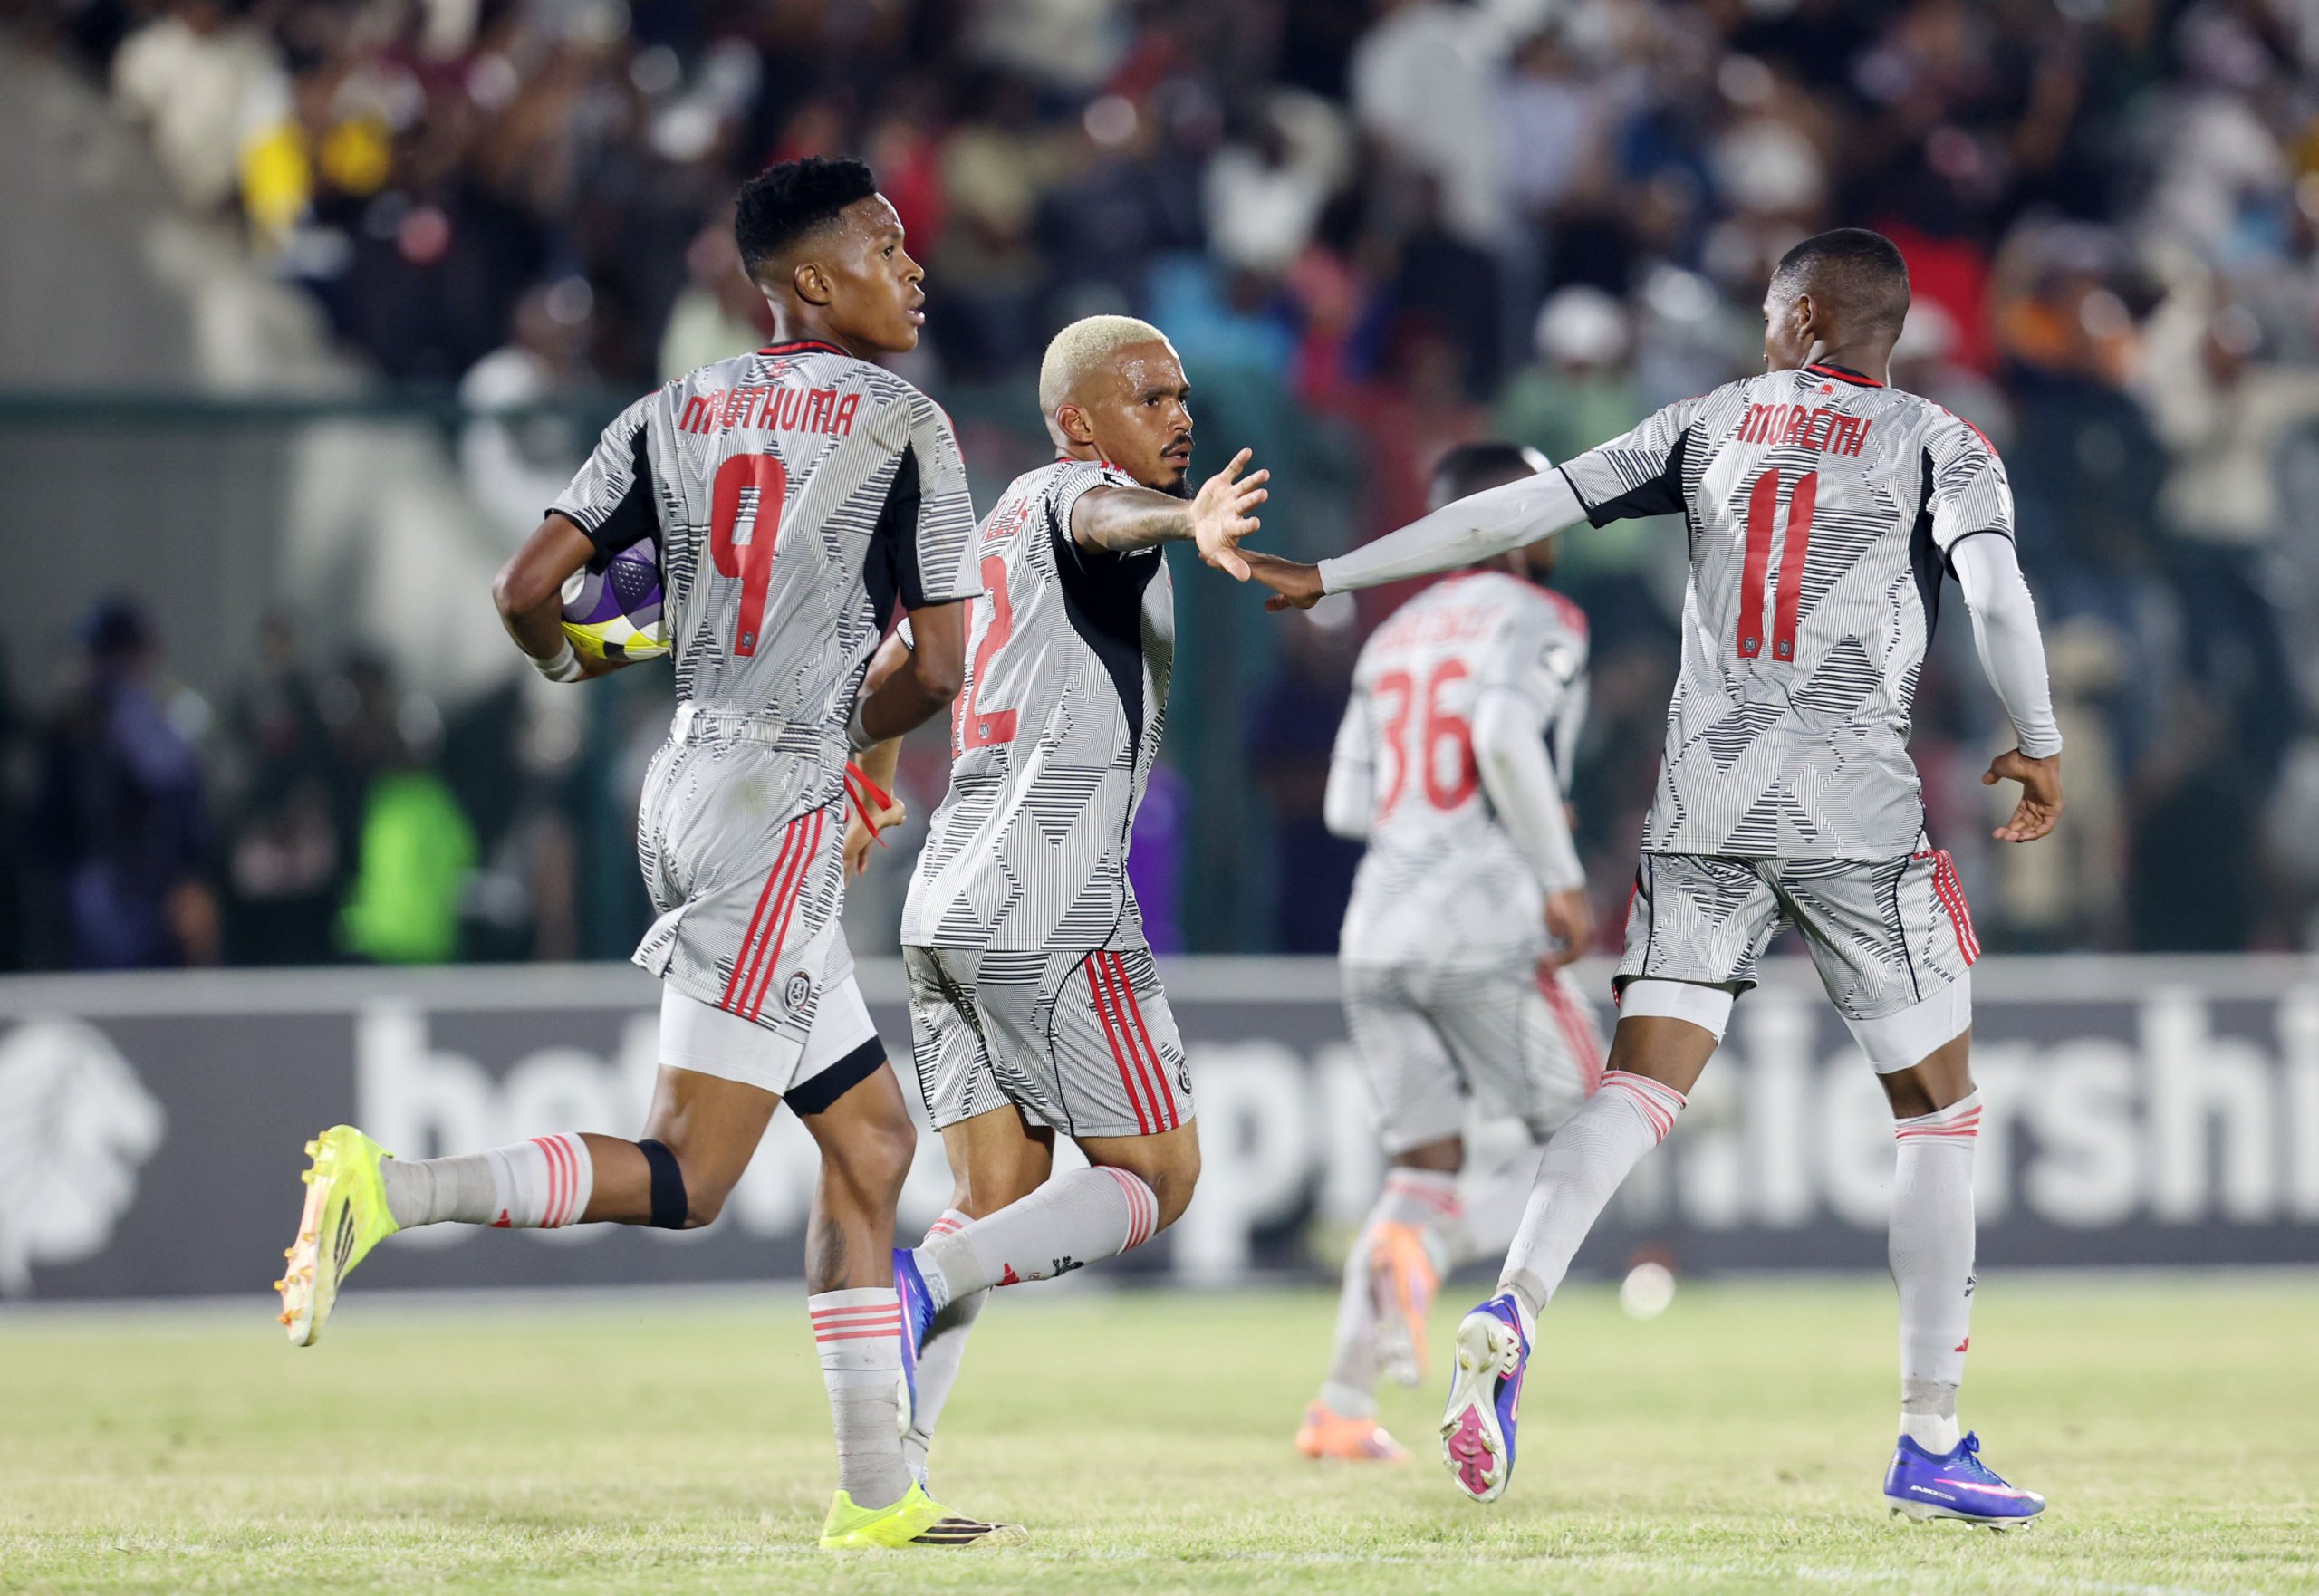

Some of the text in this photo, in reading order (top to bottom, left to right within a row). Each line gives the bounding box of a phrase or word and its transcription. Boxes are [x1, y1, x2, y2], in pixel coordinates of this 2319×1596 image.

[1737, 403, 1872, 457] MOREMI
[710, 453, 787, 657] 9
[1737, 467, 1818, 663] 11
[951, 555, 1017, 759] 2
[1373, 659, 1481, 826] 36
